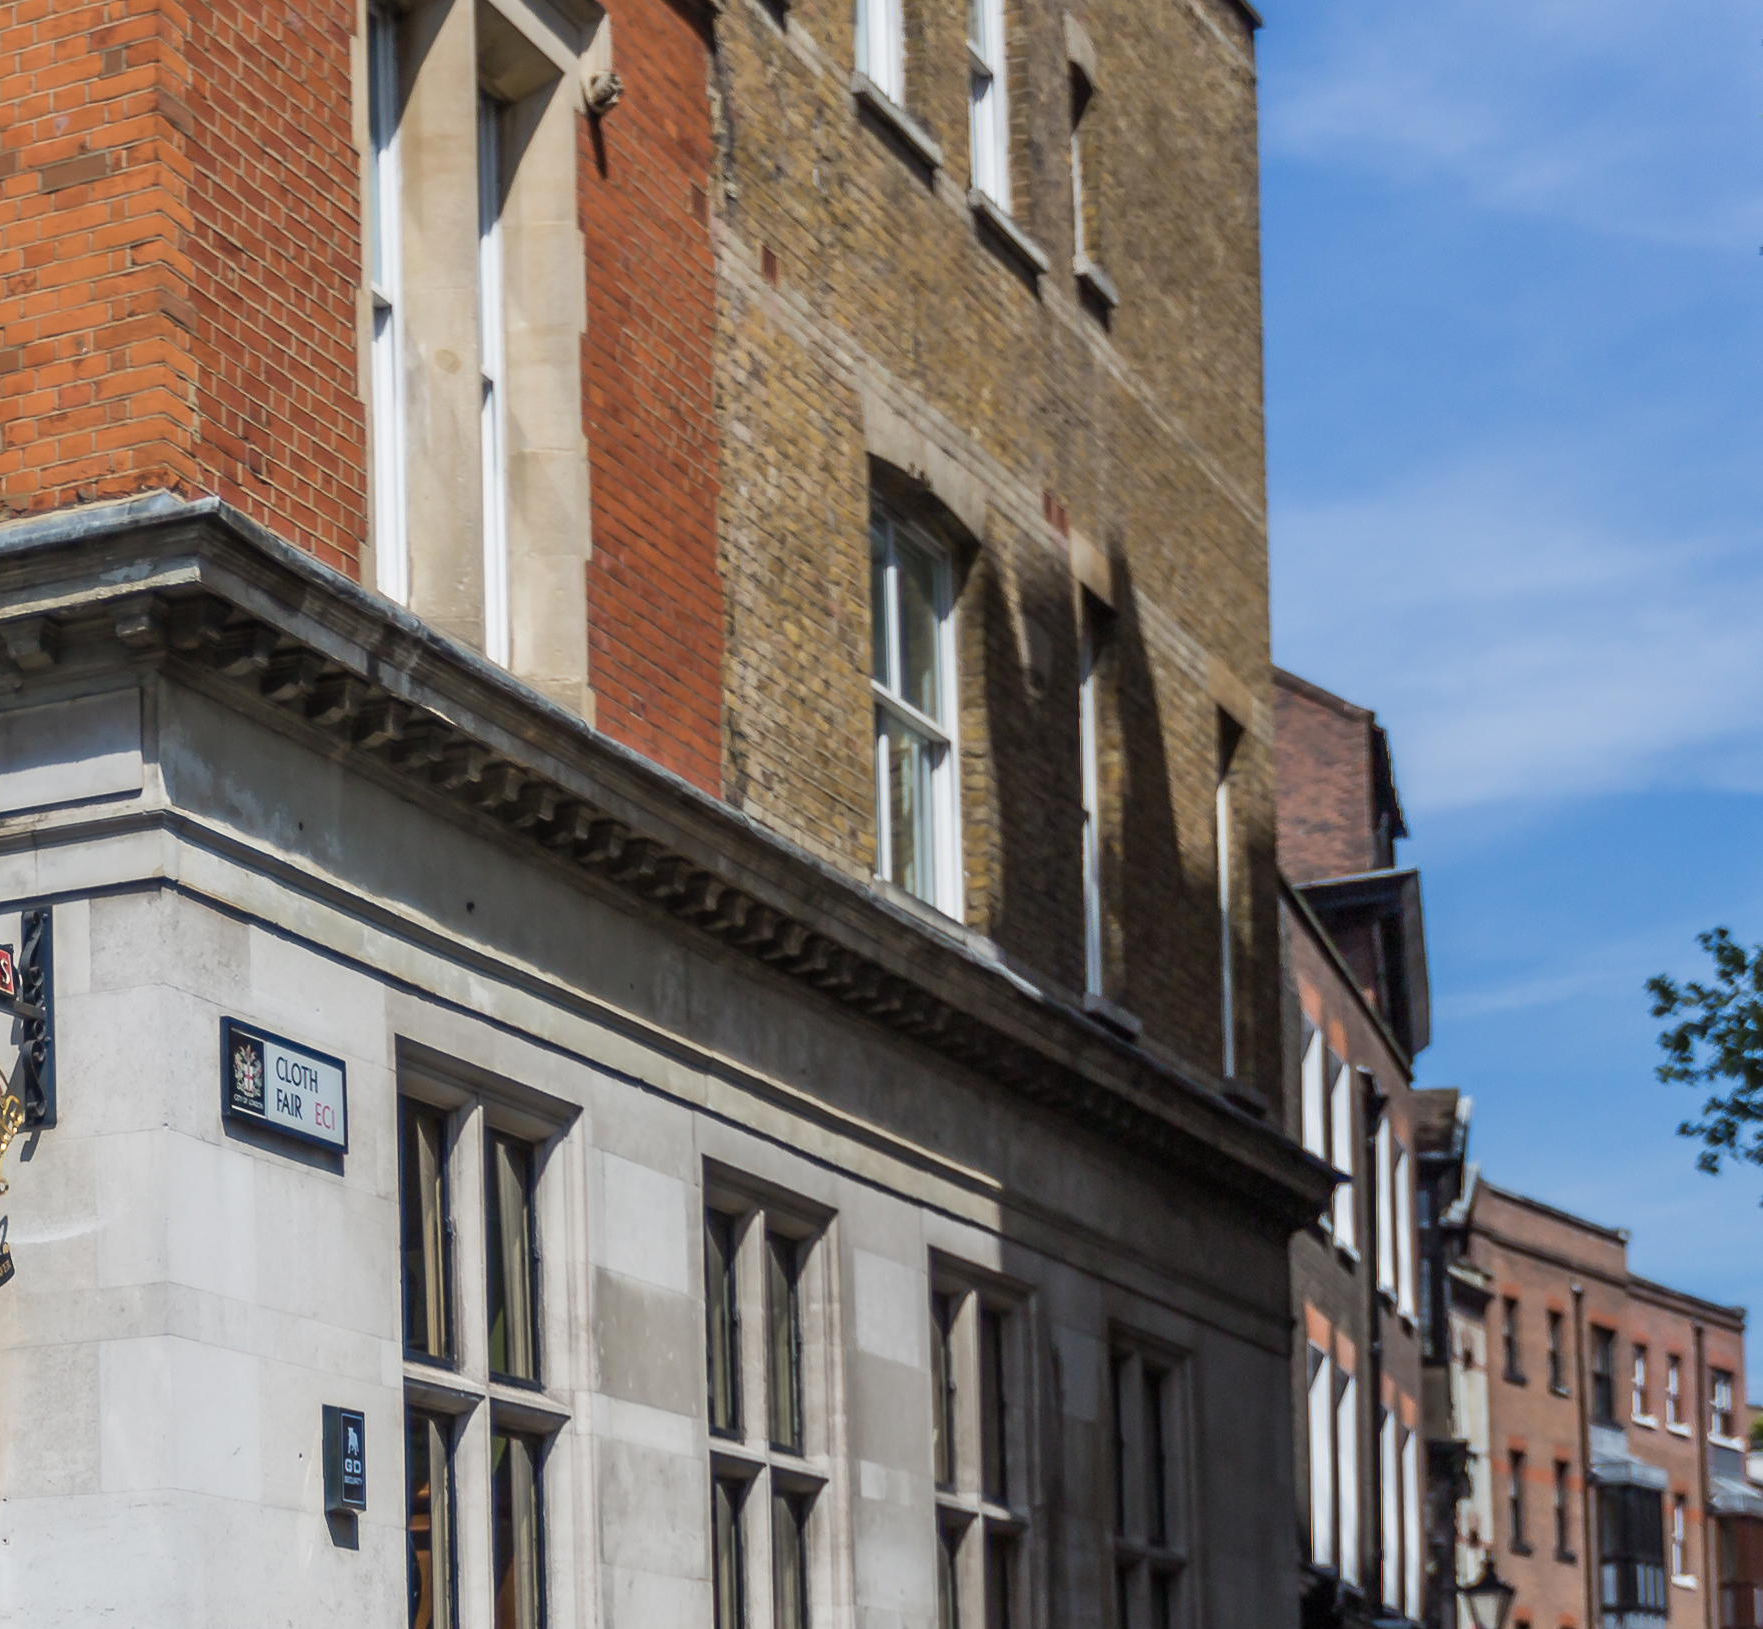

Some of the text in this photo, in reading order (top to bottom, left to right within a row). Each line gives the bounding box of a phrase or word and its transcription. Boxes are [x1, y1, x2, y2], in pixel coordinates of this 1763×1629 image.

[276, 1056, 319, 1094] CLOTH
[276, 1087, 304, 1121] FAIR
[344, 1458, 362, 1474] GD
